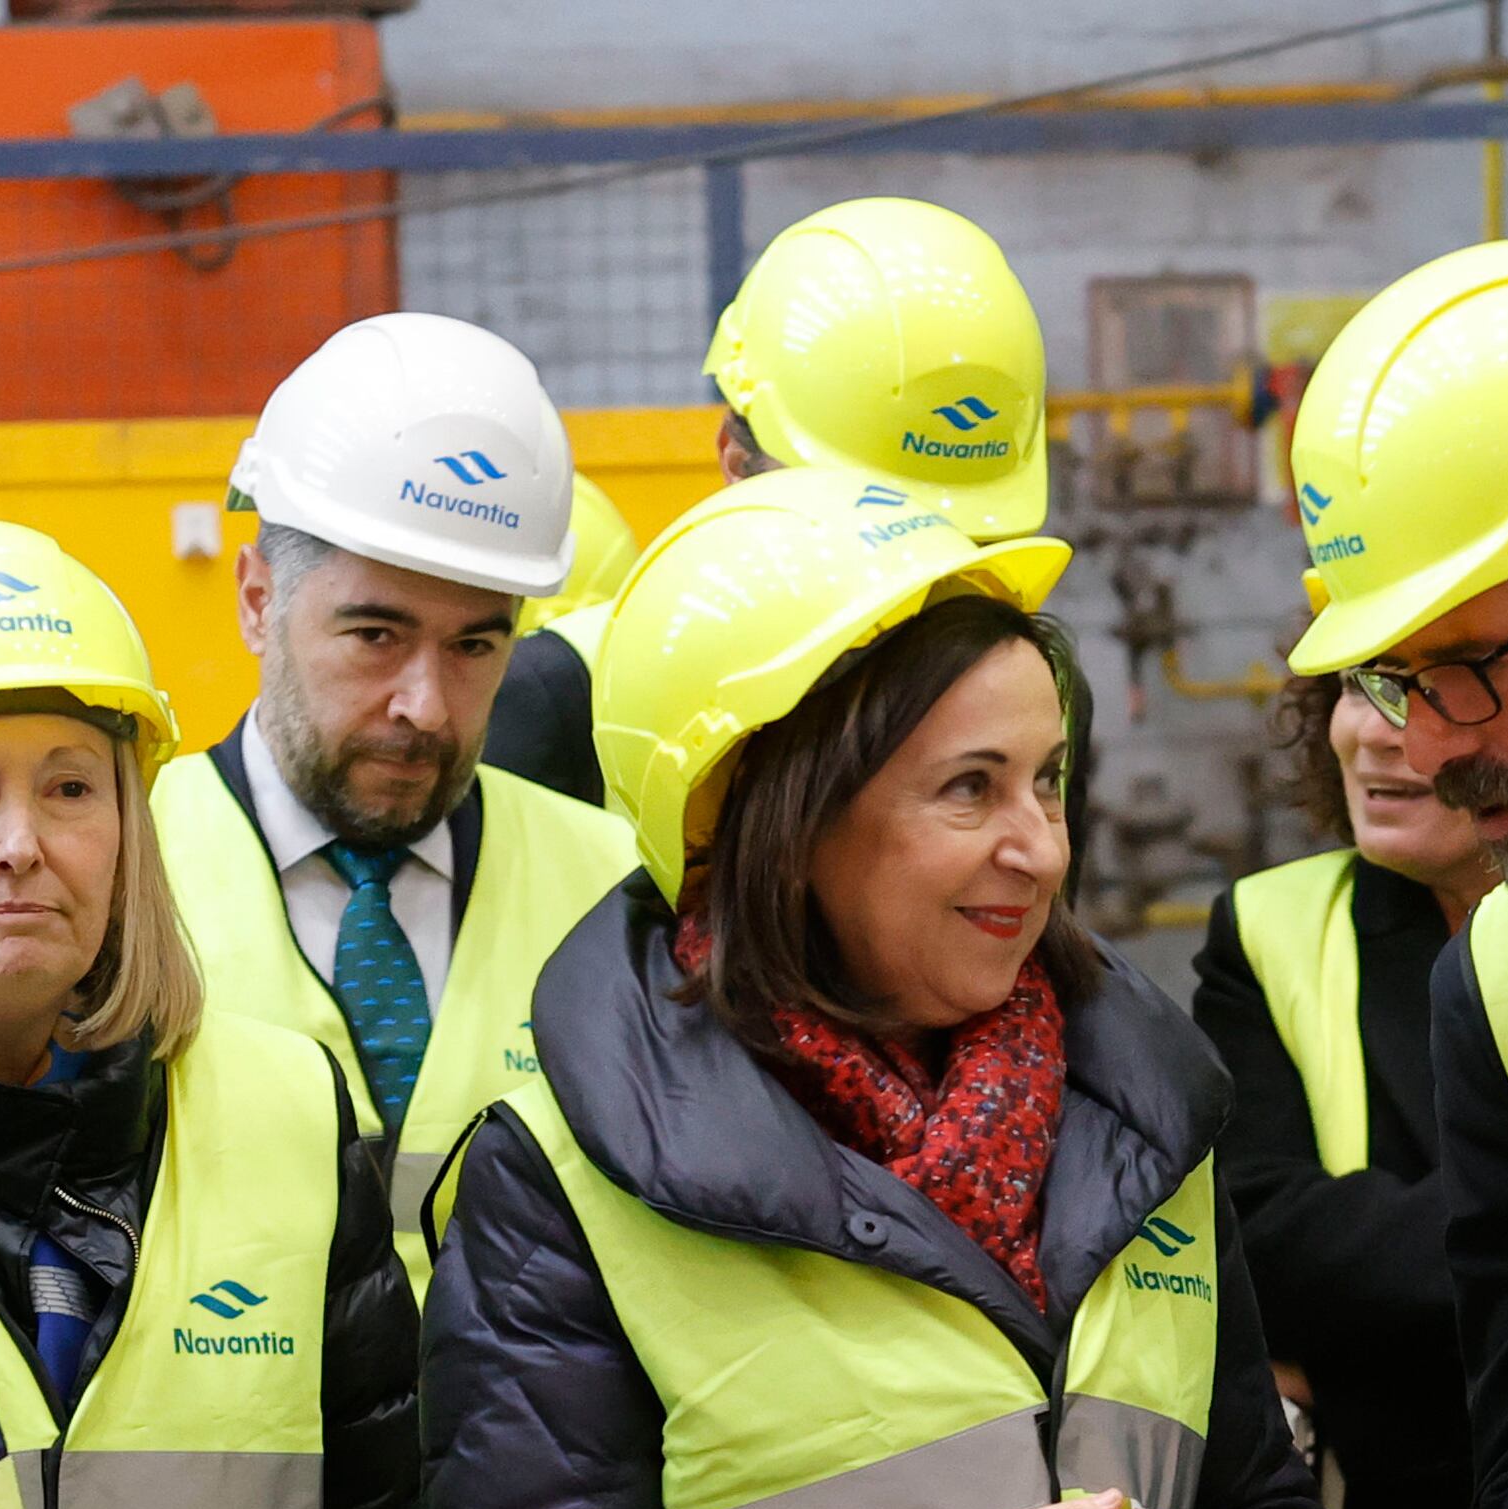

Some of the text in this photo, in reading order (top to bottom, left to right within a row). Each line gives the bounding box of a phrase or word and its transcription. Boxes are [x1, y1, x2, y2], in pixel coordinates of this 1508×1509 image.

[901, 431, 1009, 459] Navantia
[400, 479, 520, 529] Navantia
[1124, 1262, 1212, 1304] Navantia
[174, 1328, 294, 1355] Navantia
